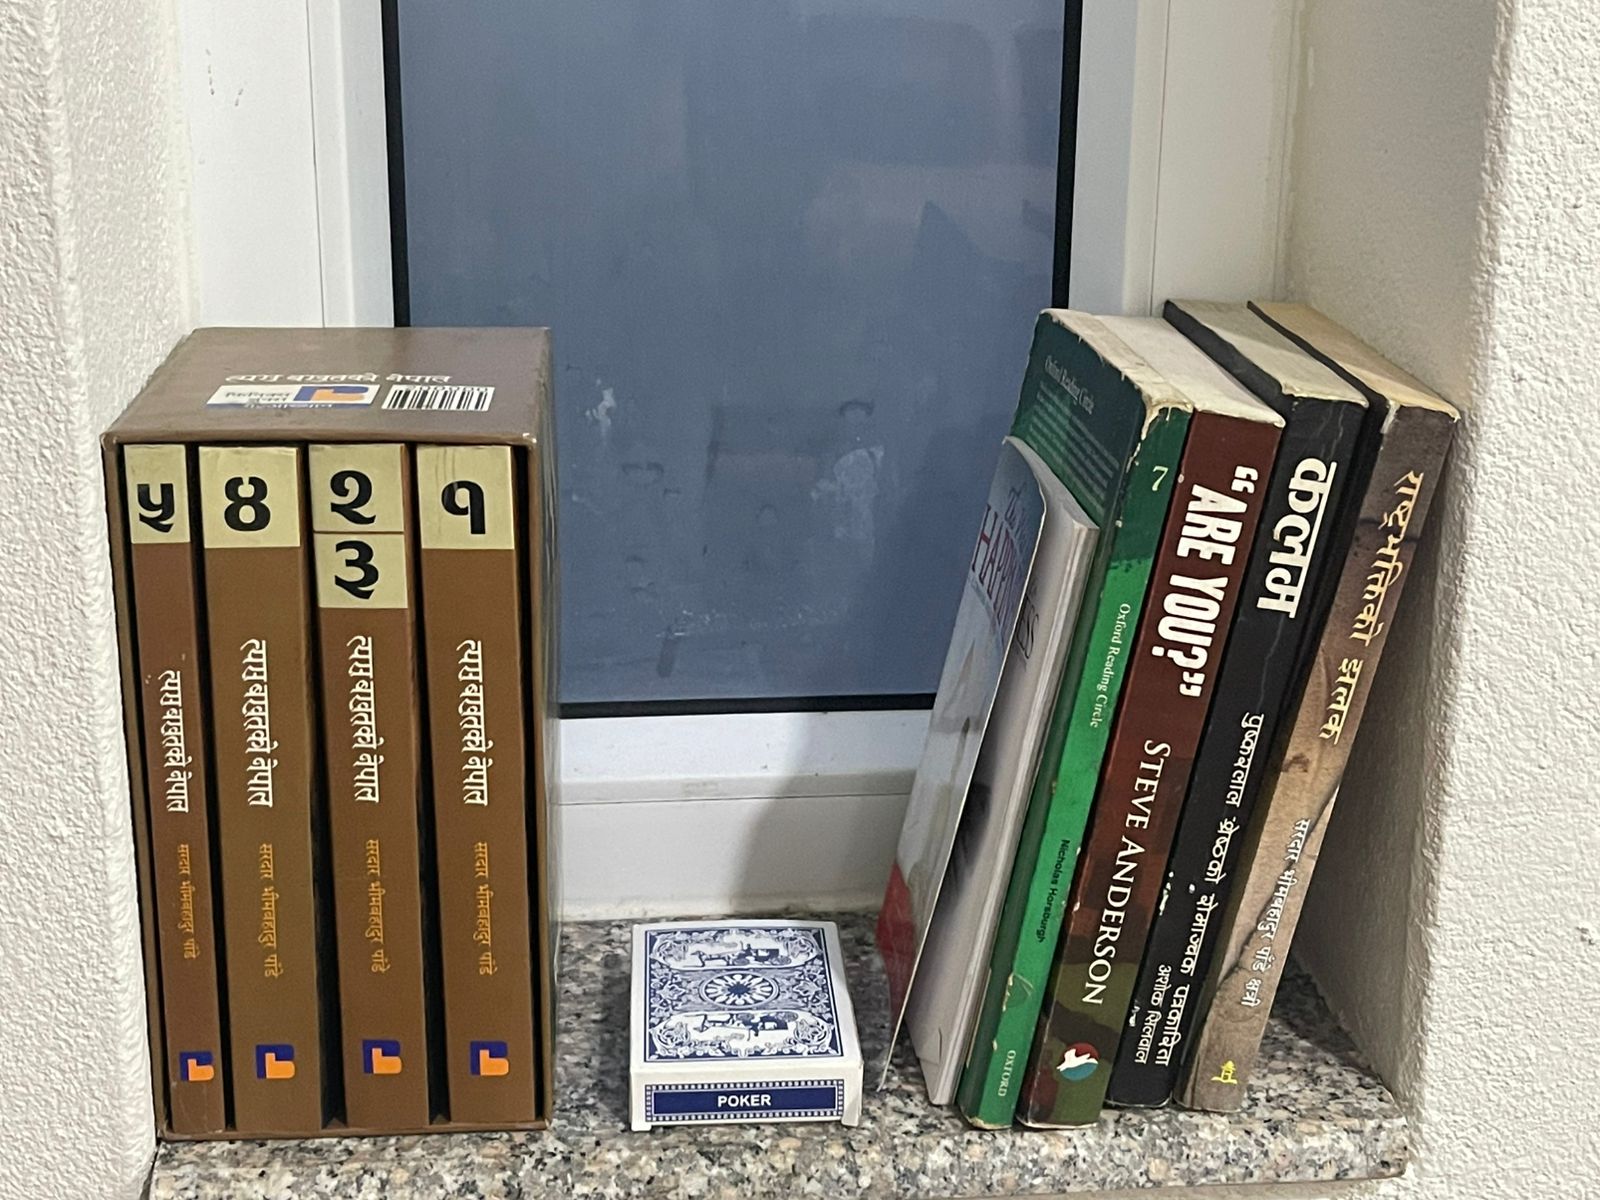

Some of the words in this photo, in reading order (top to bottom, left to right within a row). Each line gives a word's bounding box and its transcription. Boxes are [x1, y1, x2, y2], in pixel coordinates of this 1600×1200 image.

[330, 470, 376, 524] २
[1151, 465, 1169, 492] 7
[137, 483, 175, 533] ५
[224, 476, 271, 532] ४
[441, 480, 486, 534] १
[1255, 457, 1337, 618] कलम
[1349, 470, 1424, 646] राष्ट्रभक्तिको
[335, 540, 379, 600] ३
[1110, 603, 1131, 644] Oxford
[240, 638, 268, 682] त्यस
[347, 635, 374, 678] त्यस
[456, 639, 483, 682] त्यस
[1096, 646, 1120, 692] Reading
[158, 670, 182, 706] त्यस
[1089, 694, 1108, 728] Circle
[1318, 657, 1365, 745] झलक
[160, 708, 193, 767] बखतको
[242, 683, 278, 753] बखतको
[349, 679, 384, 748] बखतको
[458, 684, 493, 752] बखतको
[245, 757, 278, 807] नेपाल
[351, 753, 384, 802] नेपाल
[460, 756, 493, 805] नेपाल
[1124, 739, 1172, 829] STEVE
[1225, 712, 1265, 807] पुष्करलाल
[165, 770, 193, 813] नेपाल
[177, 844, 190, 875] सरदार
[259, 843, 274, 880] सरदार
[366, 839, 381, 876] सरदार
[473, 842, 489, 878] सरदार
[1049, 838, 1071, 885] Nicholas
[1203, 816, 1240, 883] श्रेष्ठको
[1283, 819, 1312, 865] सरदार
[177, 880, 195, 933] भीमबहादुर
[258, 886, 279, 948] भीमबहादुर
[365, 881, 386, 944] भीमबहादुर
[473, 884, 494, 946] भीमबहादुर
[1036, 888, 1058, 944] Horsburgh
[1082, 835, 1146, 1005] ANDERSON
[1257, 868, 1297, 940] भीमबहादुर
[1251, 946, 1277, 973] पाँडे
[1150, 964, 1172, 1006] अशोक
[1240, 978, 1262, 1008] क्षत्री
[1133, 1010, 1161, 1064] सिलवाल
[1154, 984, 1190, 1067] पत्रकारिता
[998, 1050, 1017, 1097] OXFORD
[717, 1094, 772, 1108] POKER
